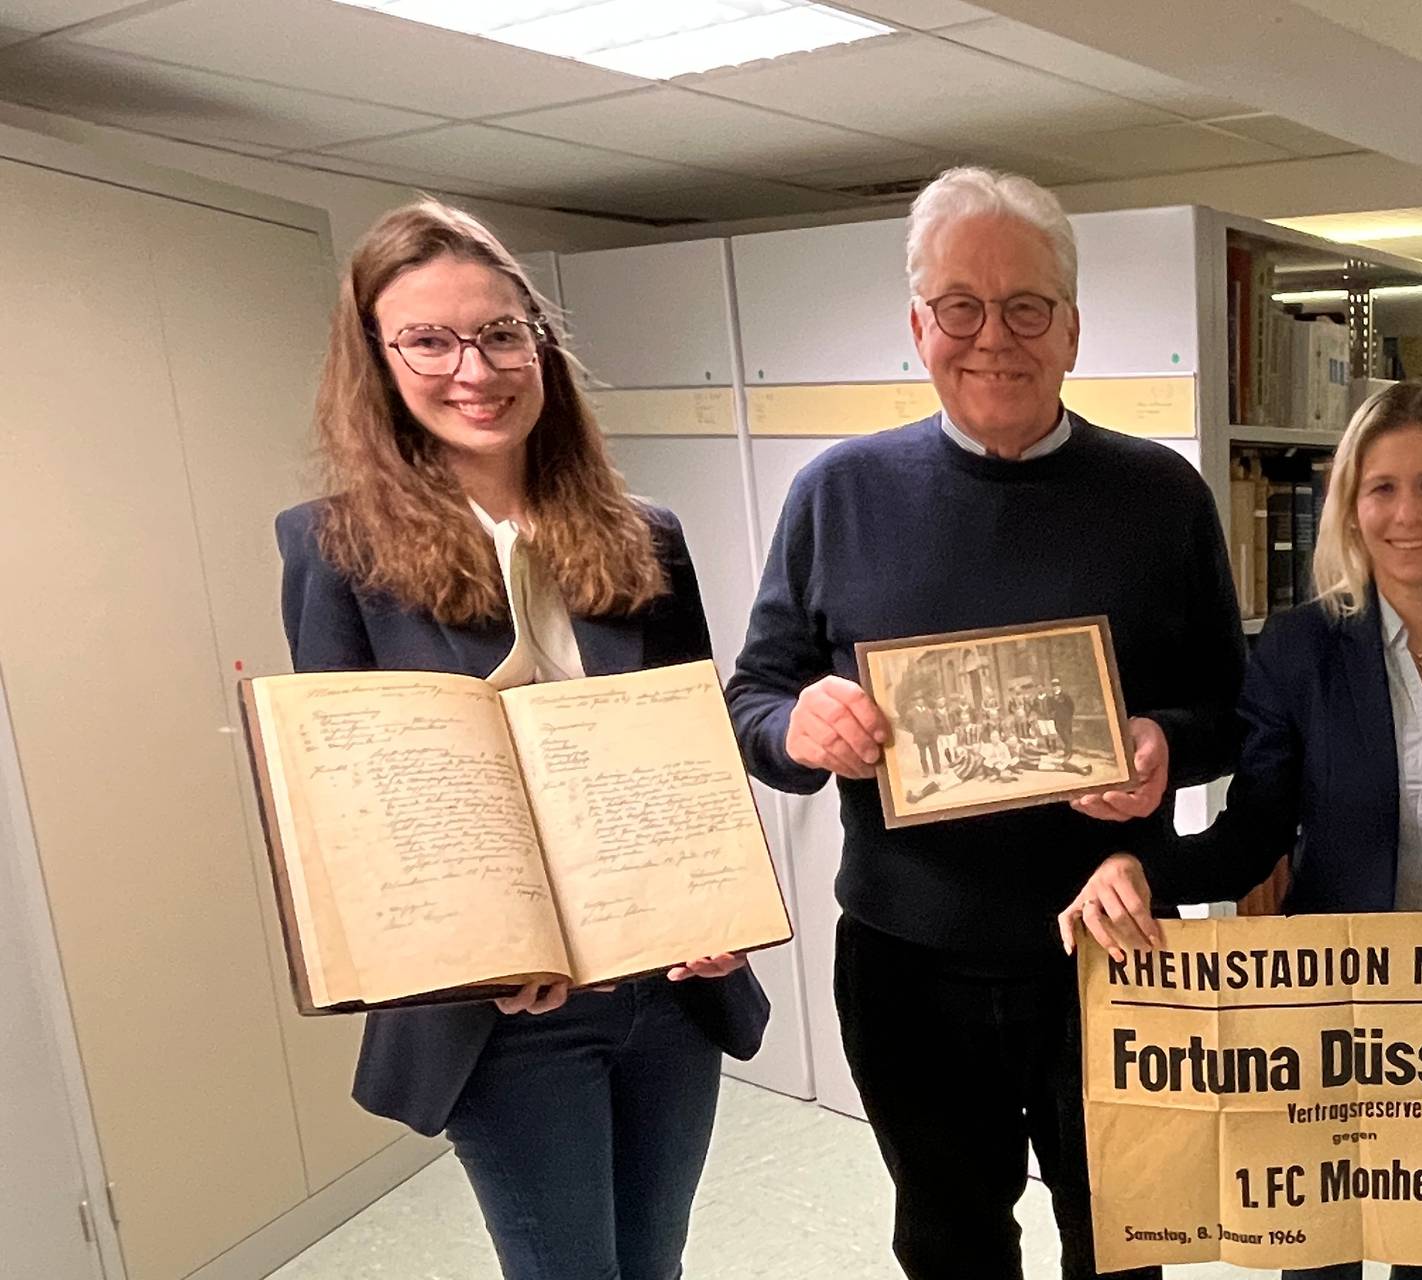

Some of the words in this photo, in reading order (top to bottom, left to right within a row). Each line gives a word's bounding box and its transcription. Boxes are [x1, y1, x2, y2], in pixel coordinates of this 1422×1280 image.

[1108, 946, 1389, 991] RHEINSTADION
[1113, 1028, 1301, 1094] Fortuna
[1287, 1101, 1422, 1124] Vertragsreserve
[1332, 1132, 1377, 1144] gegen
[1235, 1168, 1259, 1209] 1.
[1266, 1166, 1305, 1209] FC
[1124, 1225, 1192, 1245] Samstag,
[1216, 1223, 1263, 1246] Januar
[1268, 1230, 1307, 1245] 1966
